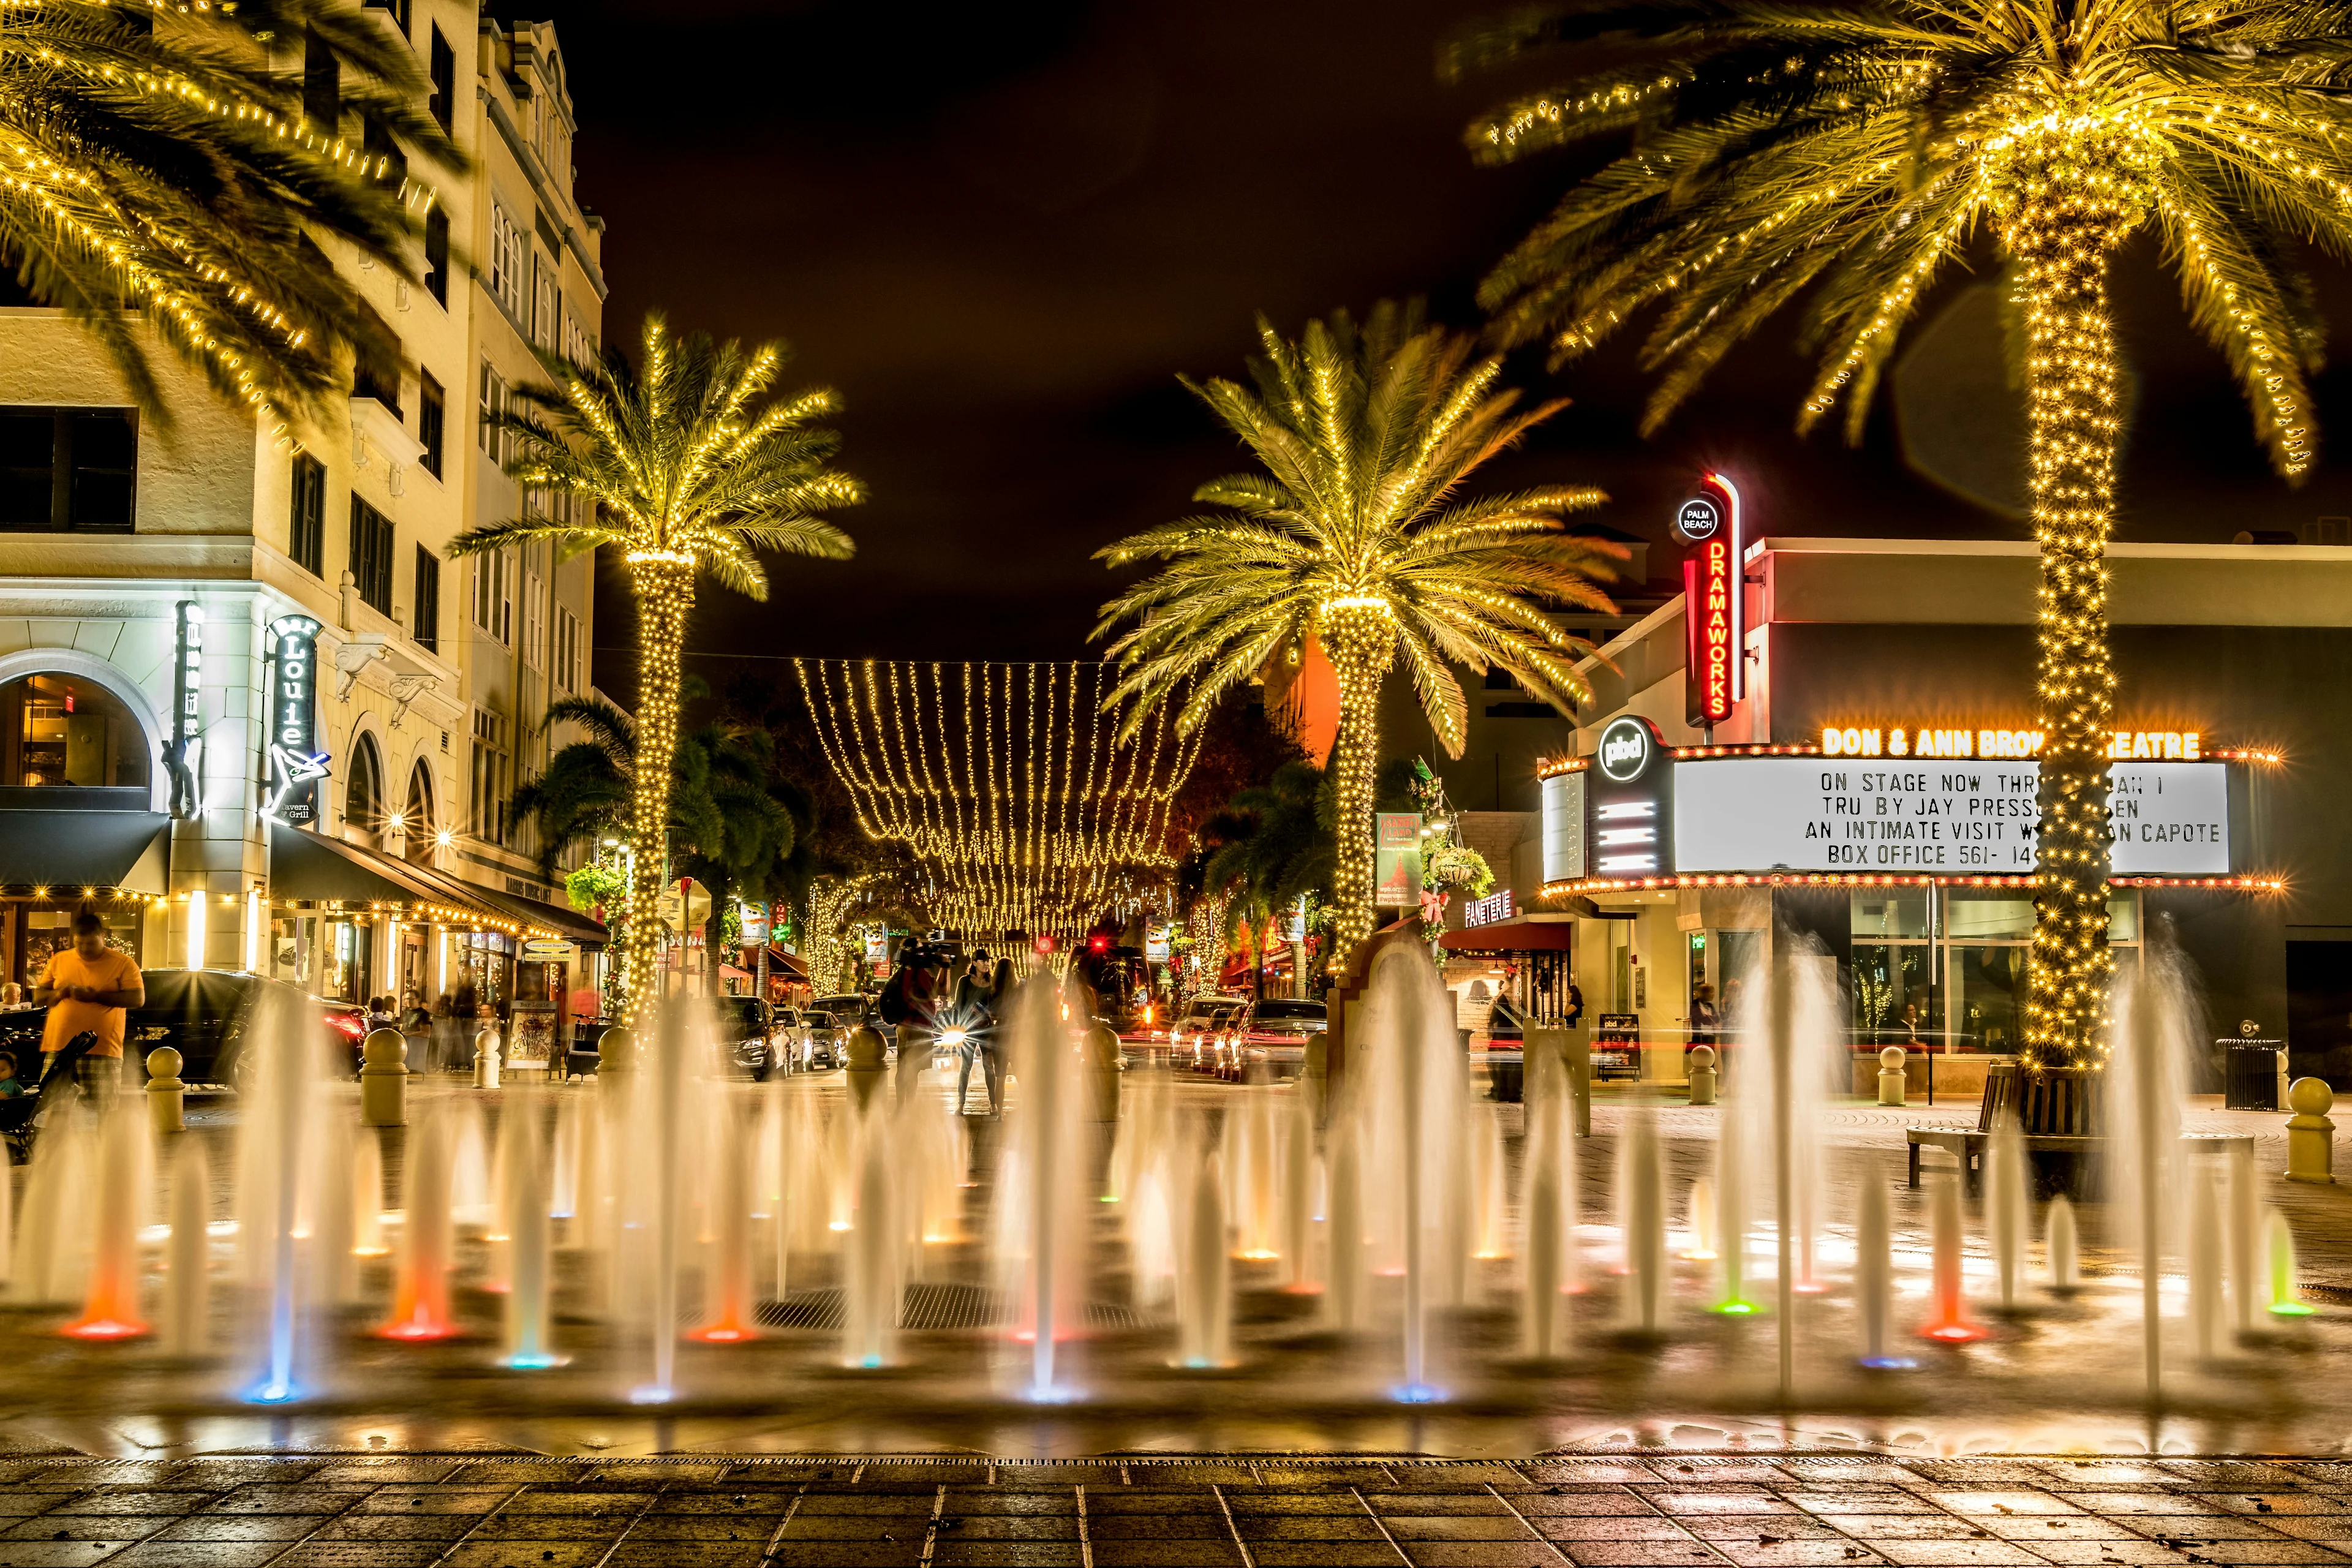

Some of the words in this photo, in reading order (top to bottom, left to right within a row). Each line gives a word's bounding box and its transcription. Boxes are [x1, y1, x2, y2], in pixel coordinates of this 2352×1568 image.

[1684, 520, 1713, 529] BEACH
[1687, 510, 1709, 519] PALM
[273, 618, 317, 636] Bar
[1708, 543, 1727, 715] DRAMAWORKS
[282, 636, 306, 745] Louie
[1605, 733, 1642, 767] pbd
[1822, 728, 1881, 755] DON
[1889, 728, 1909, 756] &
[1915, 729, 1972, 756] ANN
[1821, 772, 1847, 791] ON
[1862, 773, 1927, 792] STAGE
[1942, 774, 1981, 792] NOW
[1997, 775, 2035, 793] THR
[2111, 776, 2143, 794] AN
[1822, 797, 1861, 816] TRU
[1876, 797, 1903, 815] BY
[1915, 797, 1953, 816] JAY
[1387, 828, 1412, 837] LAND
[1805, 821, 1831, 839] AN
[1846, 821, 1940, 840] INTIMATE
[1951, 822, 2004, 840] VISIT
[2141, 824, 2220, 842] CAPOTE
[1828, 845, 1868, 864] BOX
[1877, 845, 1945, 864] OFFICE
[505, 876, 524, 897] HARRIS
[525, 882, 540, 901] MUSIC
[540, 886, 552, 903] LOFT
[1465, 889, 1511, 928] PANETERIE
